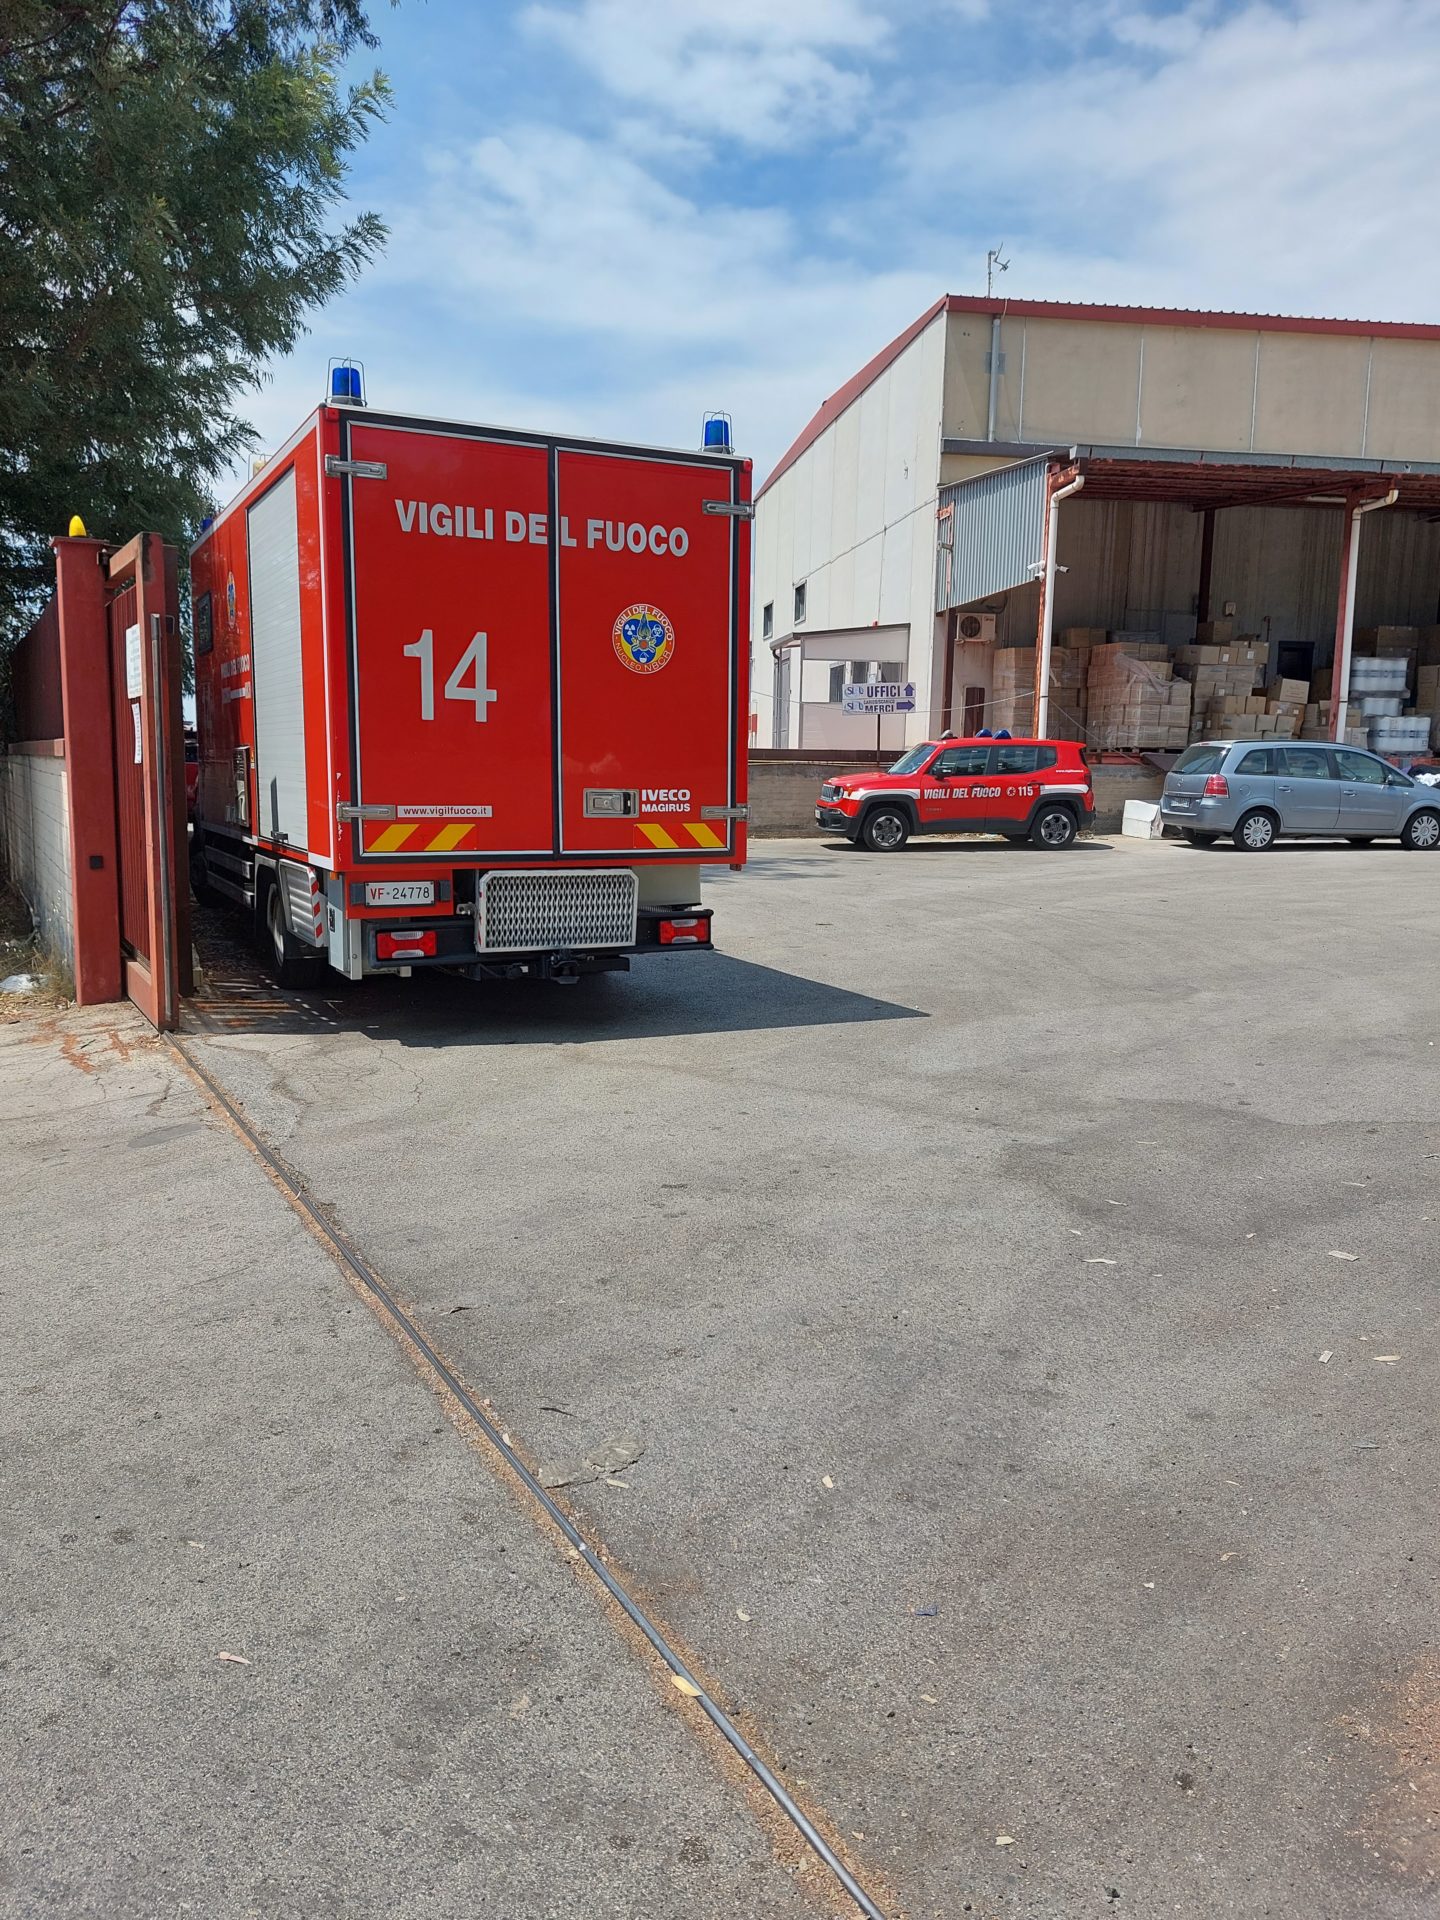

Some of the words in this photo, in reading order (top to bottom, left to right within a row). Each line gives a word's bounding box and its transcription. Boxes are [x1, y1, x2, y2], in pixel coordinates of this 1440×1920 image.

[395, 499, 494, 540] VIGILI
[505, 511, 577, 547] DEL
[587, 518, 689, 557] FUOCO
[614, 610, 632, 635] VIGILI
[632, 605, 651, 614] DEL
[651, 608, 673, 641] FUOCO
[615, 642, 642, 671] NUCLEO
[644, 650, 671, 672] NBCR
[403, 629, 497, 722] 14
[866, 685, 900, 698] UFFICI
[864, 704, 894, 714] MERCI
[641, 789, 690, 801] IVECO
[924, 788, 950, 799] VIGILI
[952, 788, 968, 799] DEL
[971, 787, 1001, 798] FUOCO
[1018, 786, 1034, 796] 115
[403, 807, 487, 816] www.vigilfuoco.it
[641, 803, 691, 812] MAGIRUS
